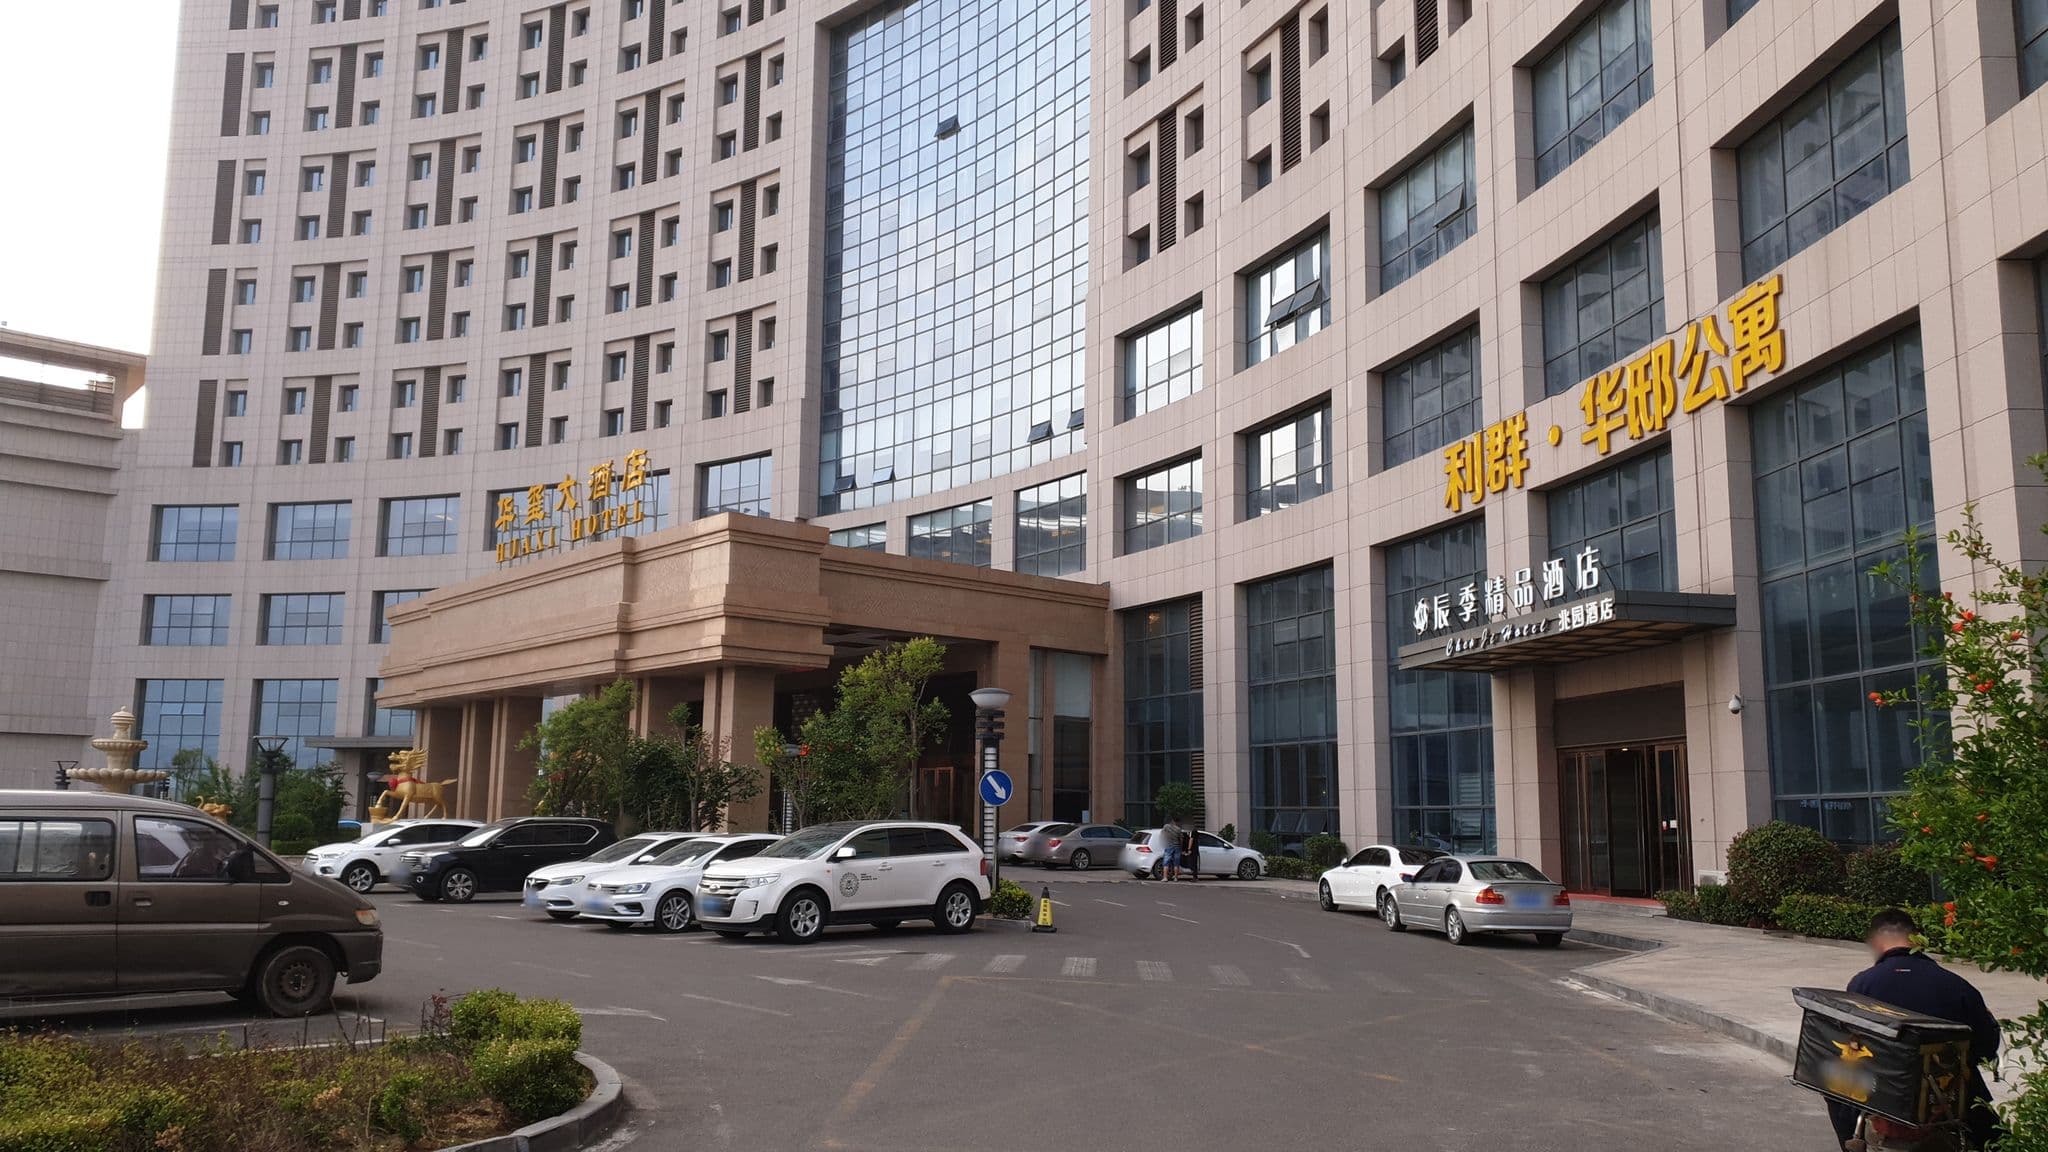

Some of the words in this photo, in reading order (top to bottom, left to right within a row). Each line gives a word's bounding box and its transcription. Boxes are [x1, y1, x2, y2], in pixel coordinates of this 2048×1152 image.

[495, 448, 648, 533] 华玺大酒店
[495, 526, 557, 563] HUAXI
[571, 500, 645, 541] HOTEL
[1433, 545, 1600, 631] 辰季精品酒店
[1501, 618, 1547, 642] Hotel
